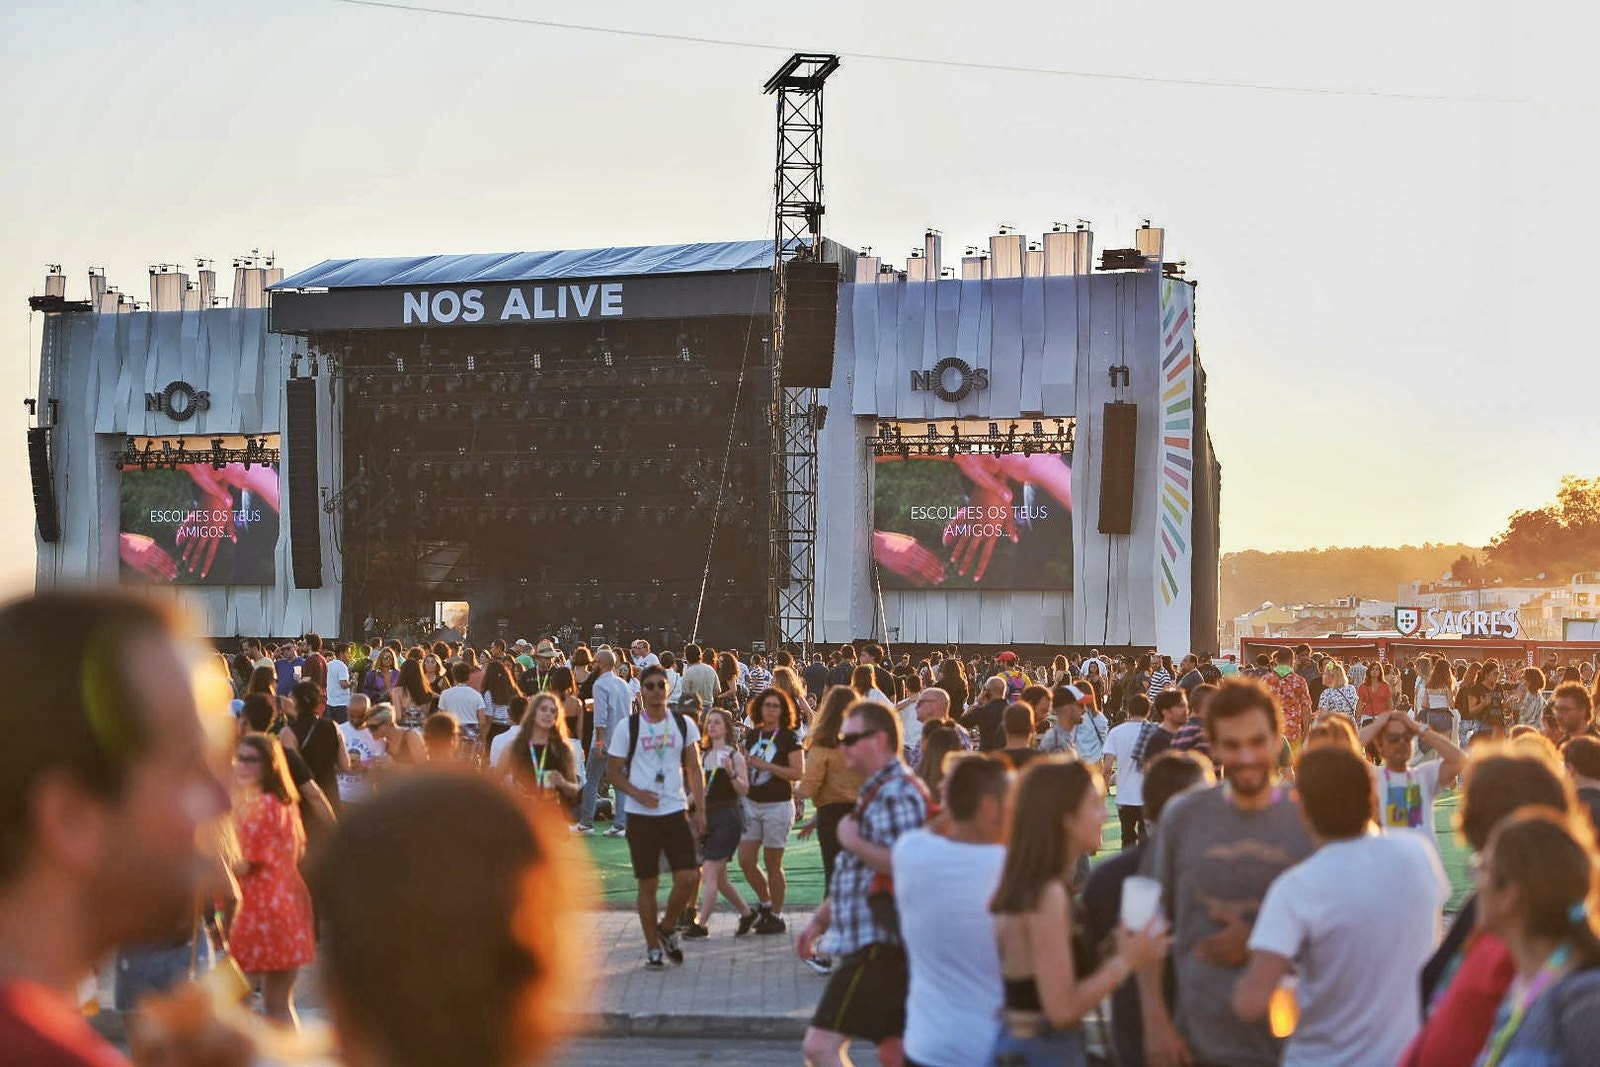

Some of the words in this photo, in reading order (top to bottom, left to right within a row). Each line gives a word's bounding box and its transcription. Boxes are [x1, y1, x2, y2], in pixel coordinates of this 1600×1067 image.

[403, 289, 485, 324] NOS
[500, 283, 623, 320] ALIVE
[910, 357, 989, 403] NOS
[144, 380, 211, 421] NOS
[150, 510, 209, 523] ESCOLHES
[213, 510, 228, 522] OS
[232, 509, 261, 522] TEUS
[911, 506, 984, 520] ESCOLHES
[987, 506, 1007, 519] OS
[1011, 505, 1048, 519] TEUS
[178, 526, 231, 538] AMIGOS...
[944, 523, 1012, 537] AMIGOS...
[1425, 607, 1519, 639] SAGRES
